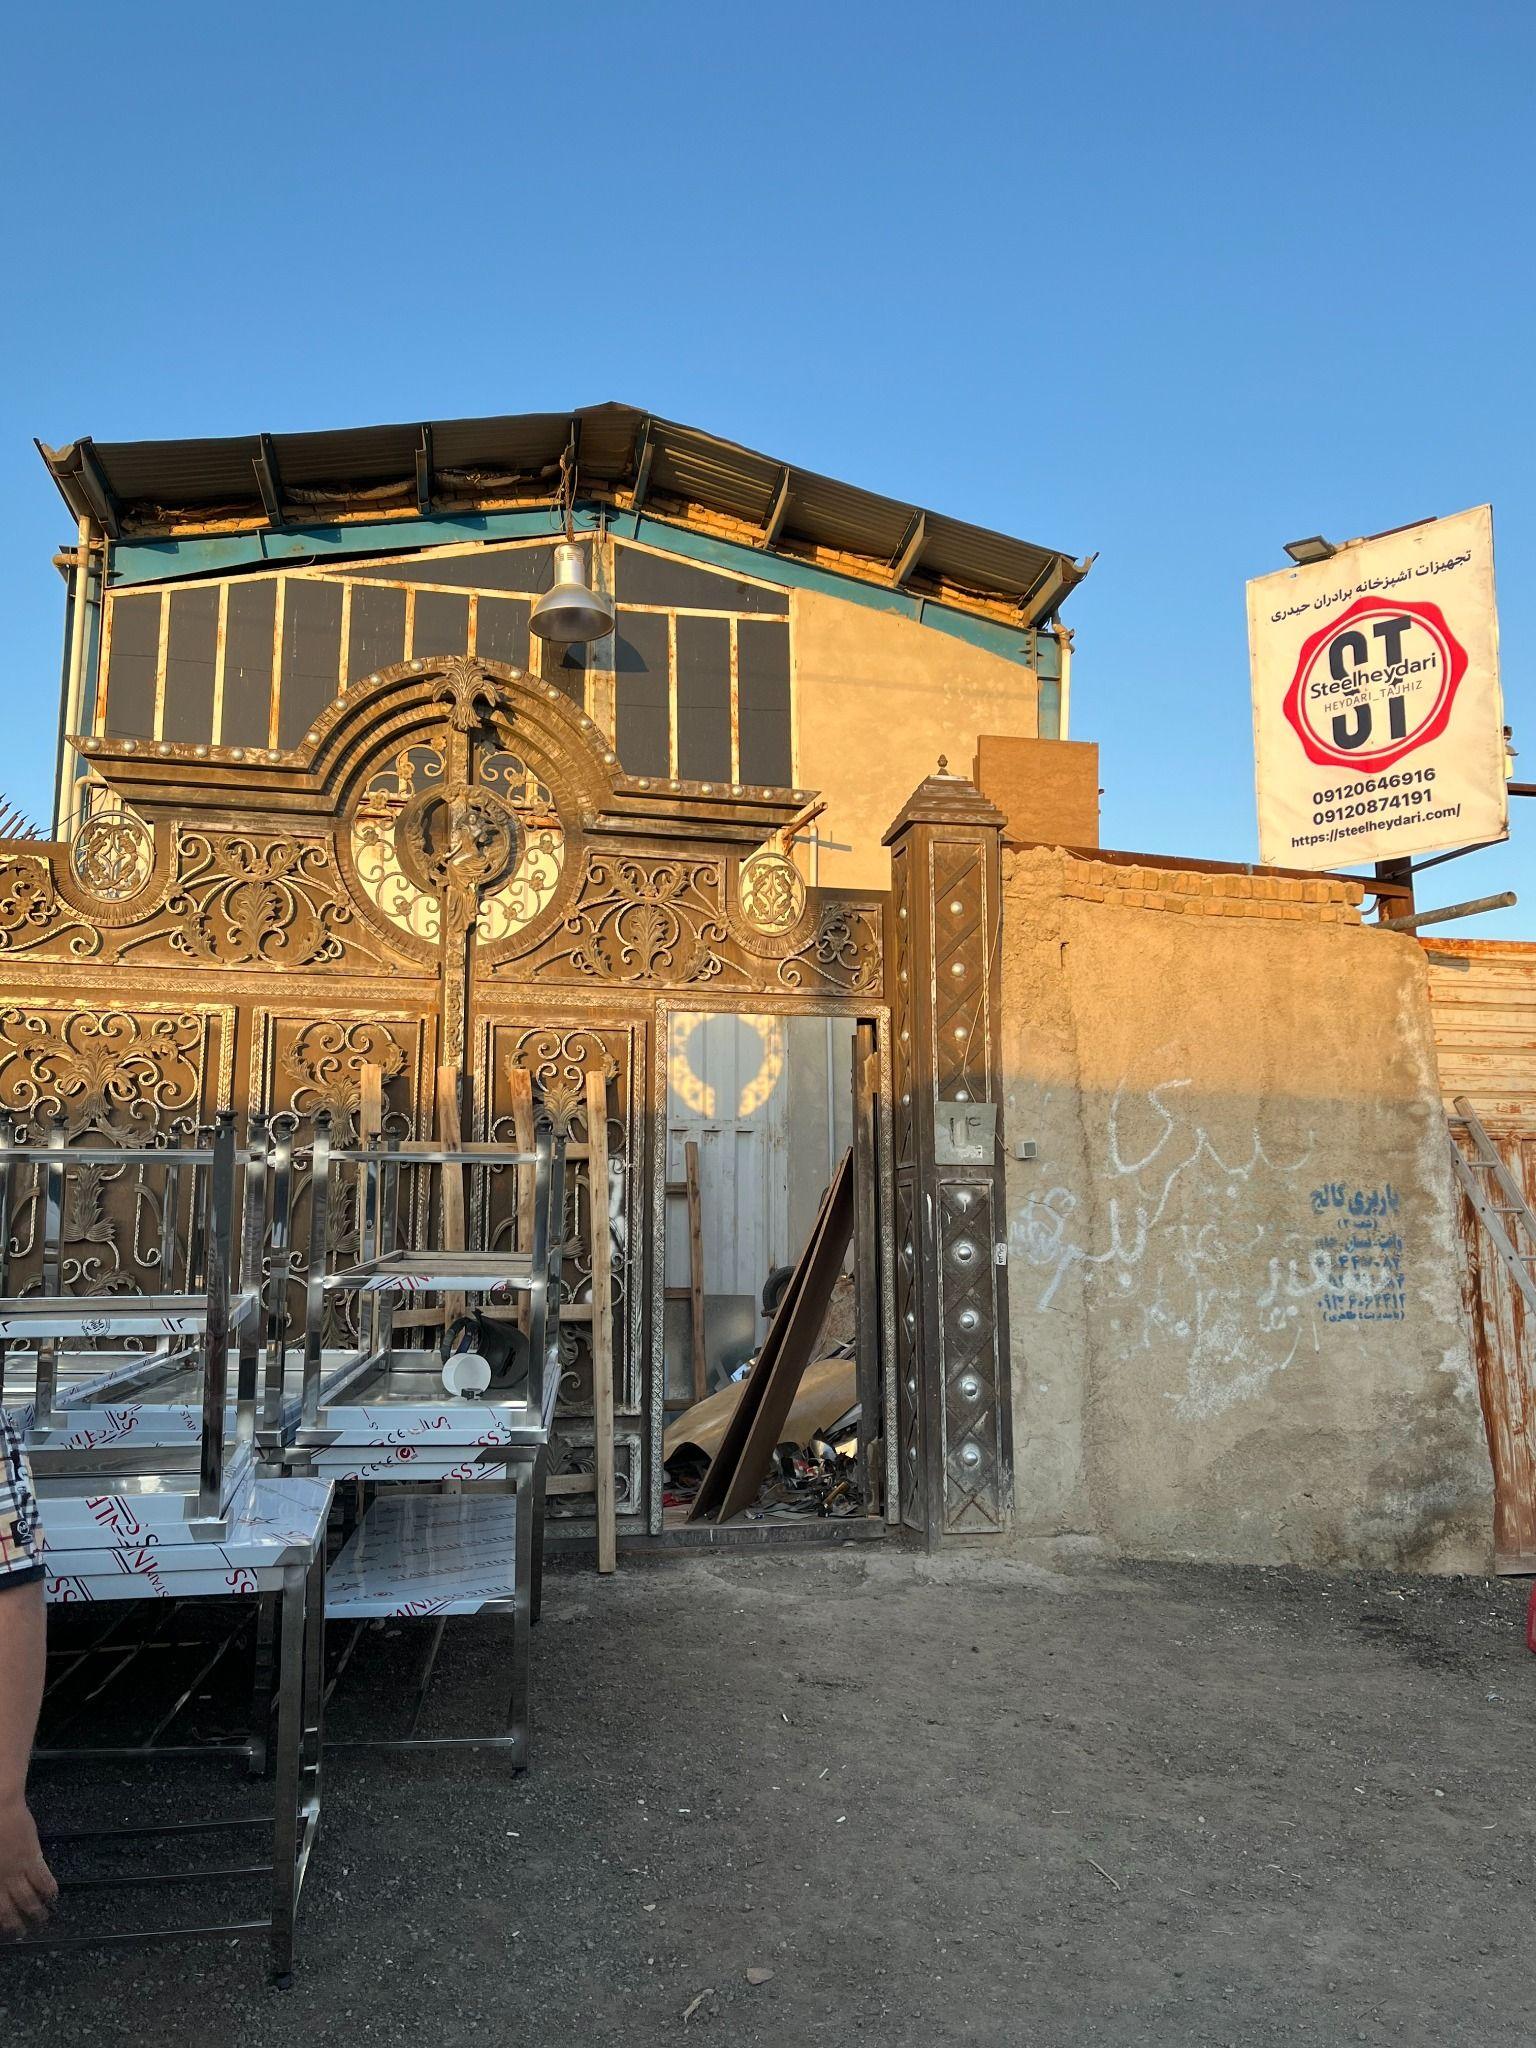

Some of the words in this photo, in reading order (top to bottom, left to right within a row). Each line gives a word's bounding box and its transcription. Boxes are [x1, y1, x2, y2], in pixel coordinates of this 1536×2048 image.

[1355, 567, 1412, 593] آشپزخانه
[1415, 549, 1471, 578] تجهیزات
[1271, 602, 1310, 623] حیدری
[1313, 587, 1353, 610] برادران
[1310, 652, 1437, 699] Steelheydari
[1312, 767, 1436, 805] 09120646916
[1312, 788, 1432, 826] 09120874191
[1291, 803, 1461, 848] https://steelheydari.com/
